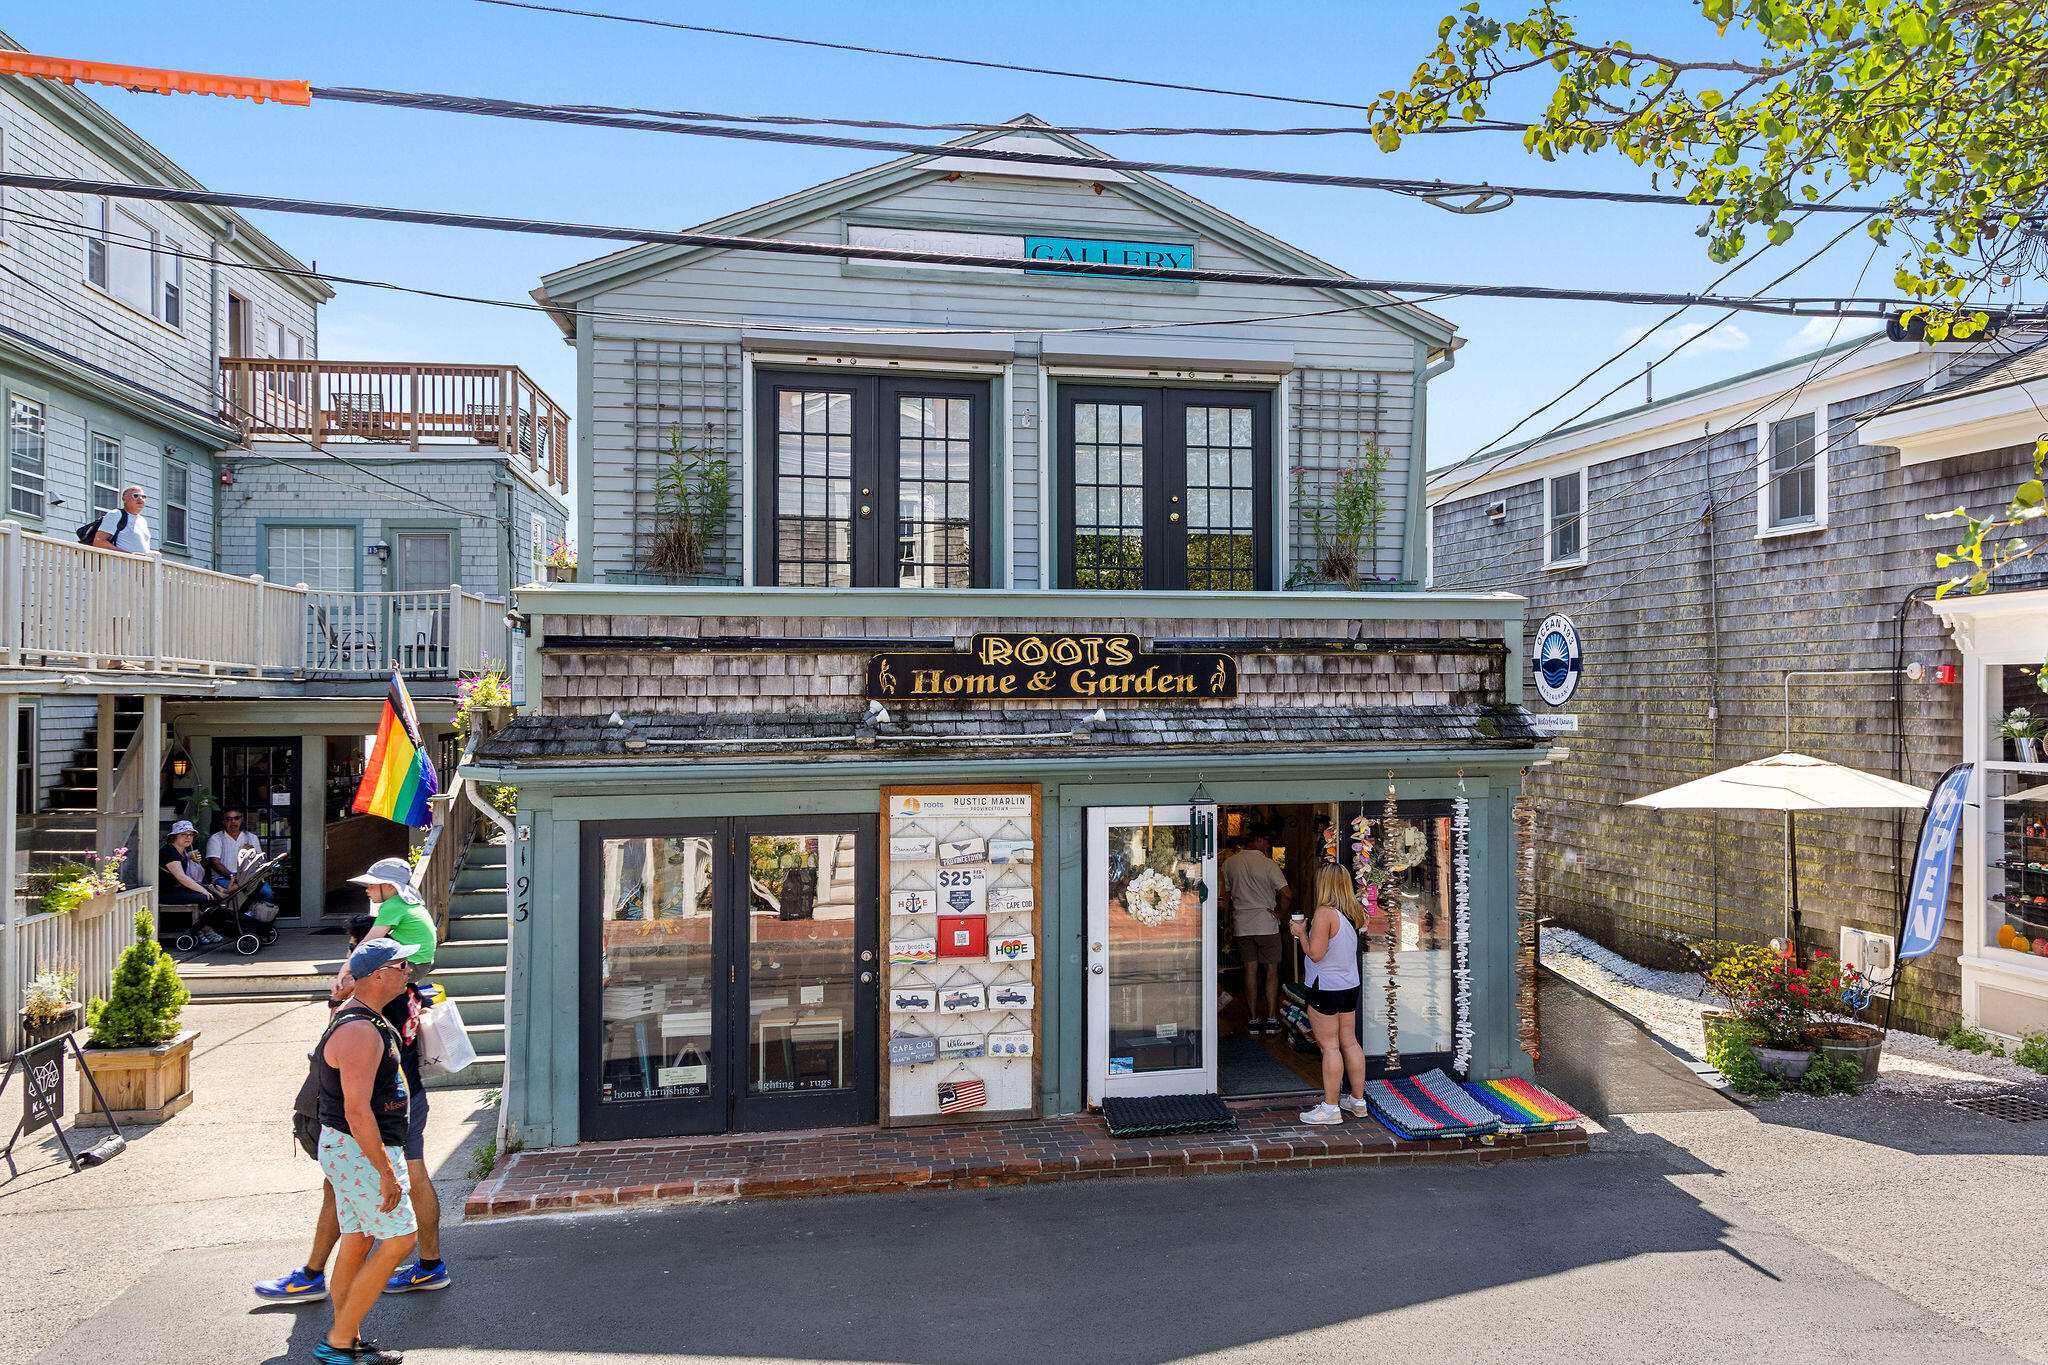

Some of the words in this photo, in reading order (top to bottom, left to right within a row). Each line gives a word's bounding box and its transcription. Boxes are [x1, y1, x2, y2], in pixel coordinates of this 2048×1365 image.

[1031, 245, 1187, 270] GALLERY
[1536, 618, 1562, 646] OCEAN
[1562, 624, 1575, 646] 193
[979, 637, 1134, 666] ROOTS
[910, 669, 1018, 694] Home
[1026, 670, 1056, 690] &
[1070, 665, 1198, 695] Garden
[1540, 685, 1570, 701] RESTAURANT
[954, 797, 987, 806] RUSTIC
[991, 797, 1025, 805] MARLIN
[1913, 788, 1961, 941] OPEN
[516, 846, 529, 922] 193
[939, 871, 972, 887] $25
[898, 899, 928, 908] HOPE
[1006, 901, 1020, 910] CAPE
[1021, 900, 1033, 908] COD
[995, 943, 1028, 956] HOPE
[892, 1043, 914, 1053] CAPE
[915, 1041, 933, 1050] COD
[947, 1039, 975, 1049] Welcome
[614, 1089, 642, 1099] home
[643, 1085, 700, 1098] furnishings
[757, 1079, 795, 1091] lighting
[809, 1079, 832, 1089] rugs
